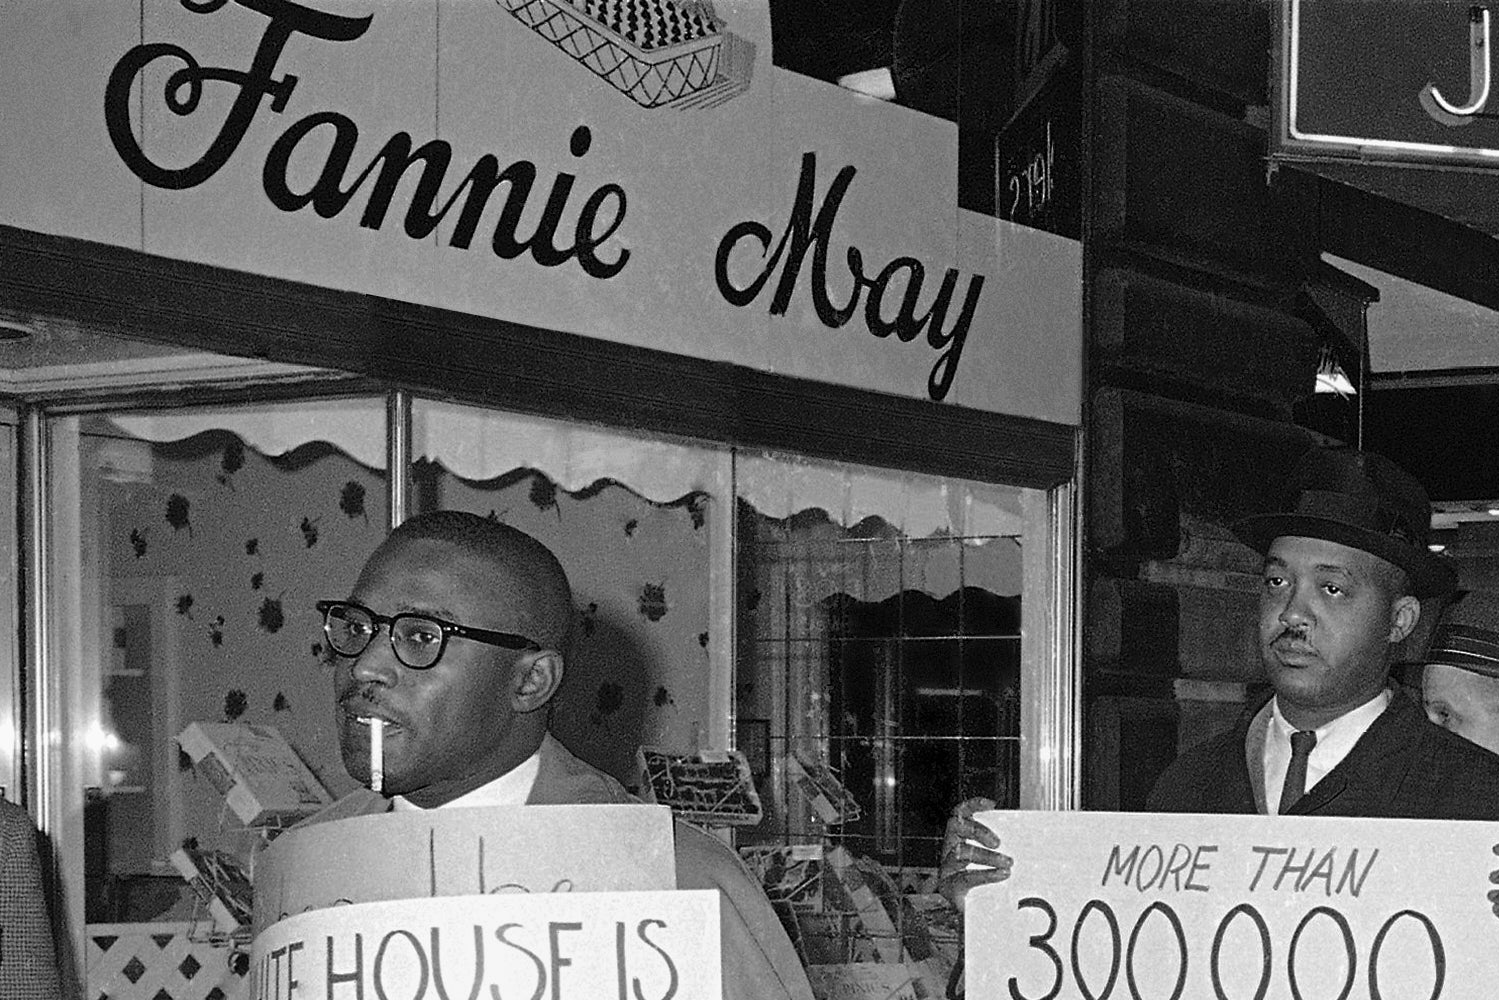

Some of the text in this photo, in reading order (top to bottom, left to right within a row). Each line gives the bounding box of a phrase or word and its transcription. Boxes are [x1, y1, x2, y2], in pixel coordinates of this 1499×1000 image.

[104, 0, 985, 401] Fannie May
[1102, 843, 1379, 898] MORE THAN
